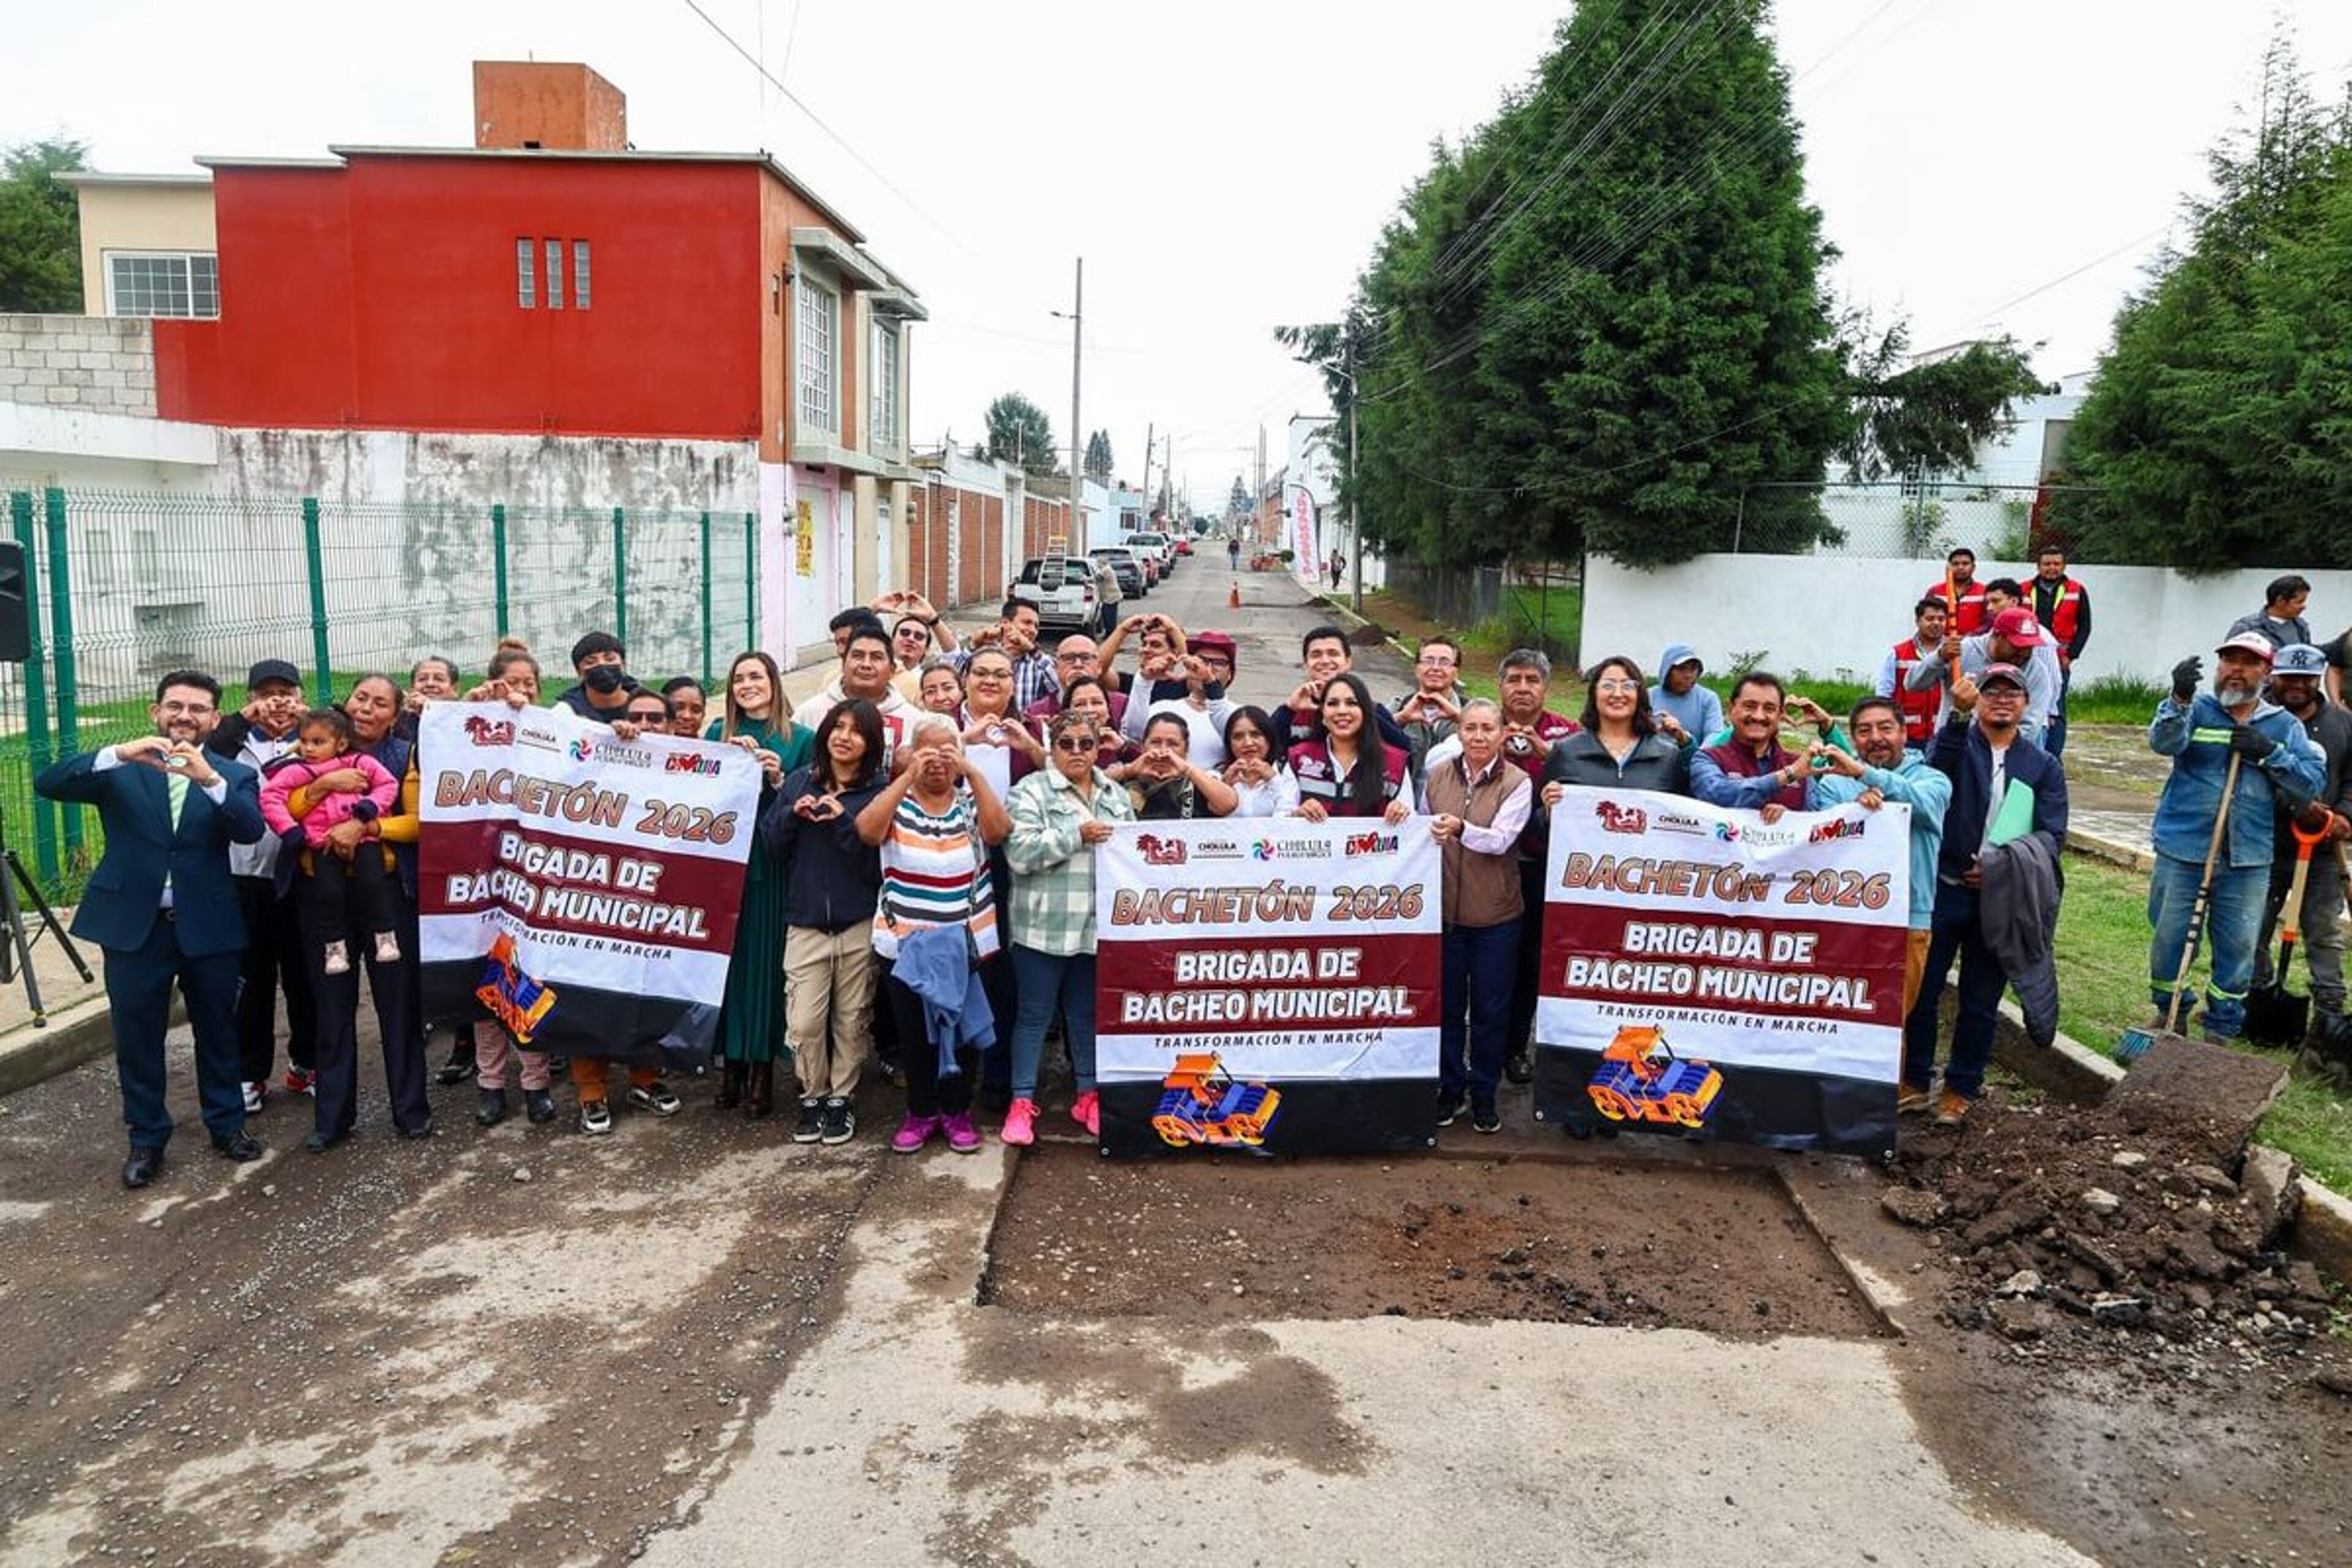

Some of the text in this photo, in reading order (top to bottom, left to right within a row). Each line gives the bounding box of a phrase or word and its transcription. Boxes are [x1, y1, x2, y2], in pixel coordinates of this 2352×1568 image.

[635, 799, 738, 845] 2026
[617, 860, 663, 892] DE
[1562, 853, 1890, 908] BACHETÓN 2026
[541, 888, 708, 939] MUNICIPAL
[1112, 879, 1423, 925] BACHETÓN 2026
[584, 938, 604, 950] EN
[610, 943, 671, 959] MARCHA
[1624, 921, 1817, 963] BRIGADA DE
[1176, 948, 1361, 982] BRIGADA DE
[1566, 959, 1875, 1011] BACHEO MUNICIPAL
[1122, 987, 1414, 1023] BACHEO MUNICIPAL
[1597, 1005, 1838, 1034] TRANSFORMACIÓN EN MARCHA
[1155, 1032, 1383, 1048] TRANSFORMACIÓN EN MARCHA
